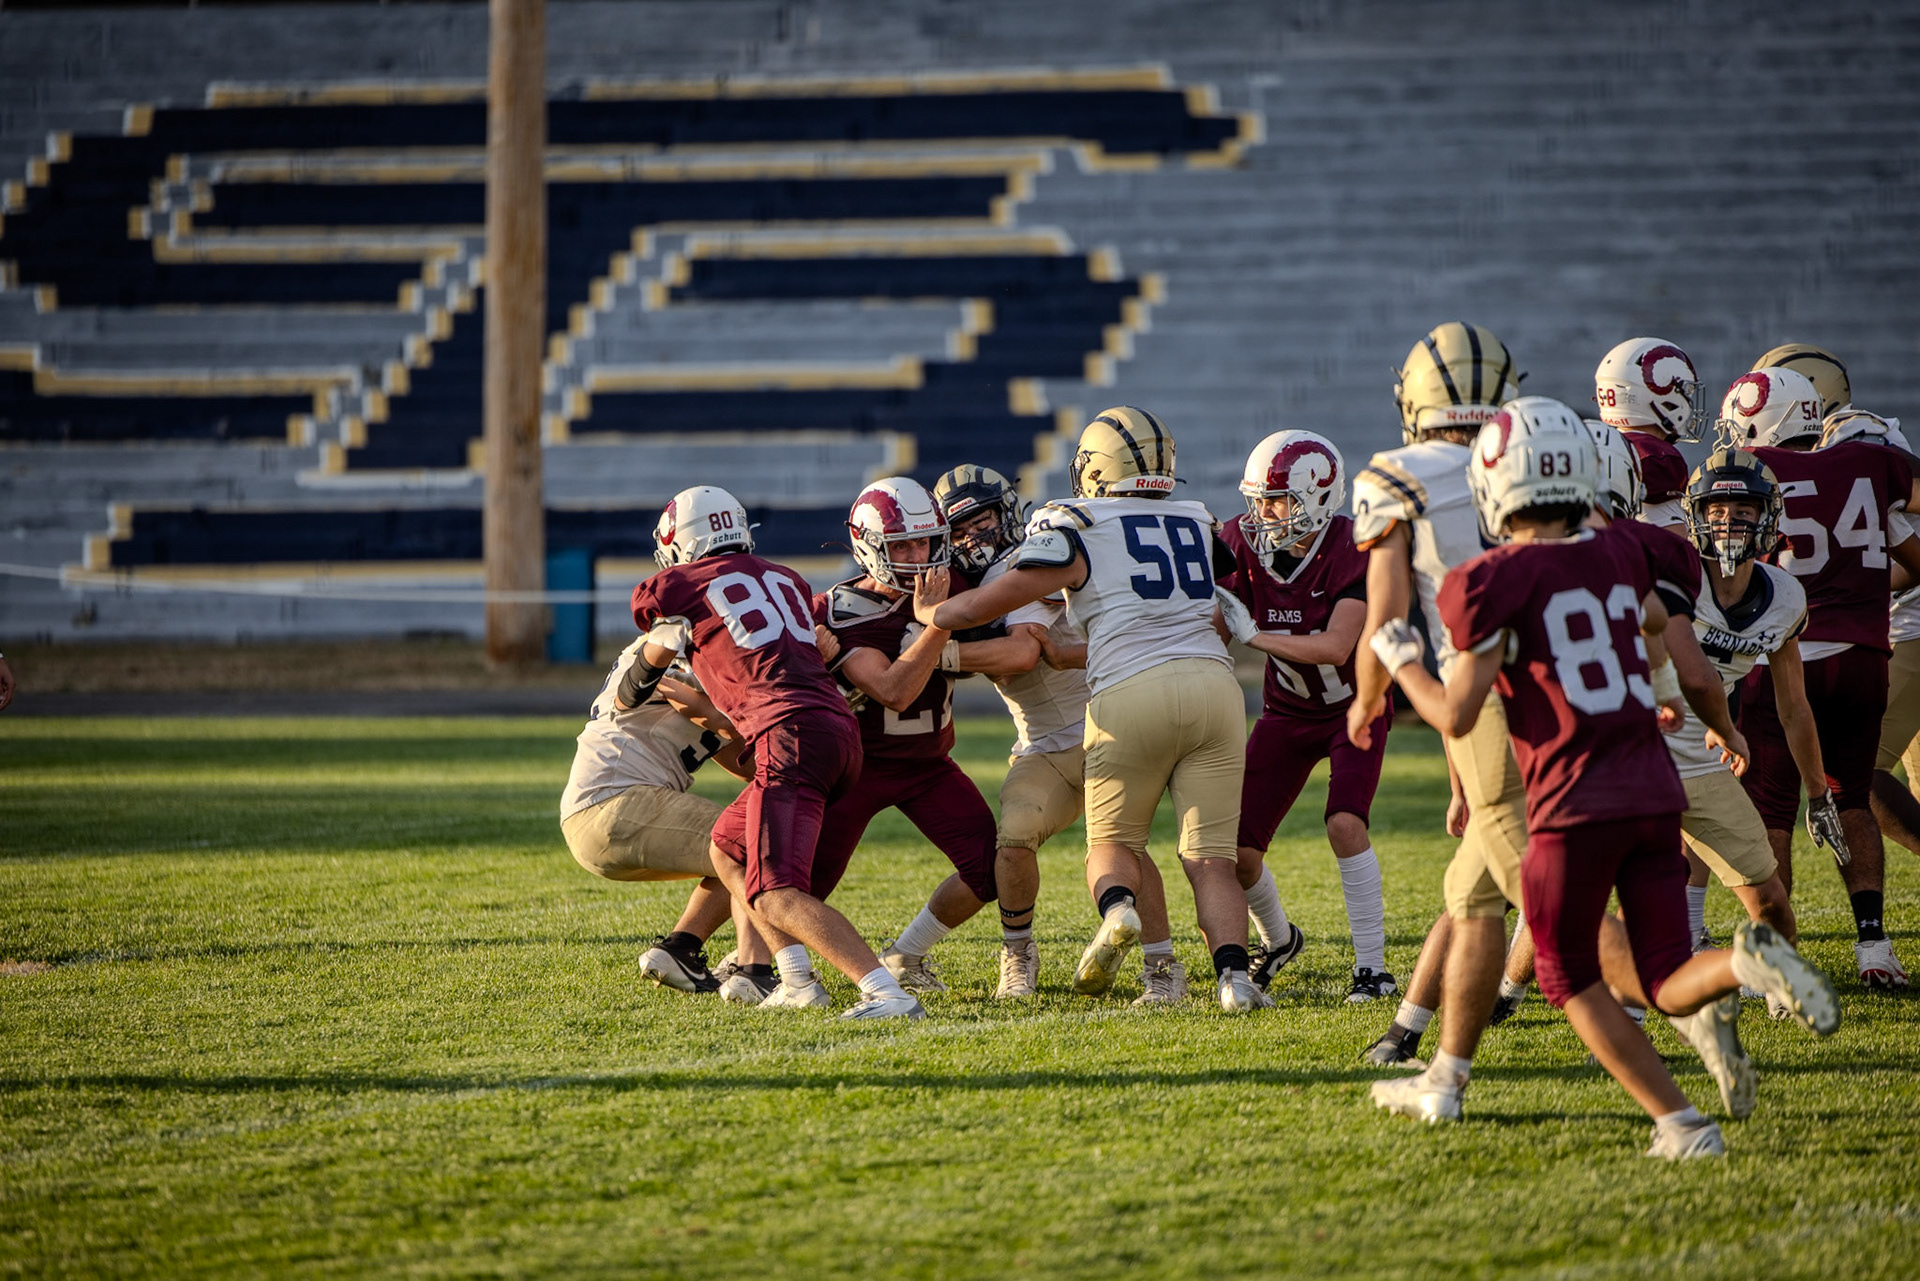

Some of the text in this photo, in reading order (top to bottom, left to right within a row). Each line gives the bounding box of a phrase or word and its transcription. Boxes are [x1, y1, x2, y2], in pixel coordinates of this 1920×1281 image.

[1802, 401, 1819, 421] 54
[1540, 452, 1571, 477] 83
[1135, 478, 1174, 490] Riddell
[708, 510, 733, 532] 80
[913, 522, 935, 531] Riddell
[1778, 477, 1888, 577] 54
[713, 532, 742, 545] schutt
[1120, 515, 1215, 600] 58
[706, 569, 817, 651] 80
[1267, 609, 1302, 623] RAMS
[1542, 583, 1657, 716] 83
